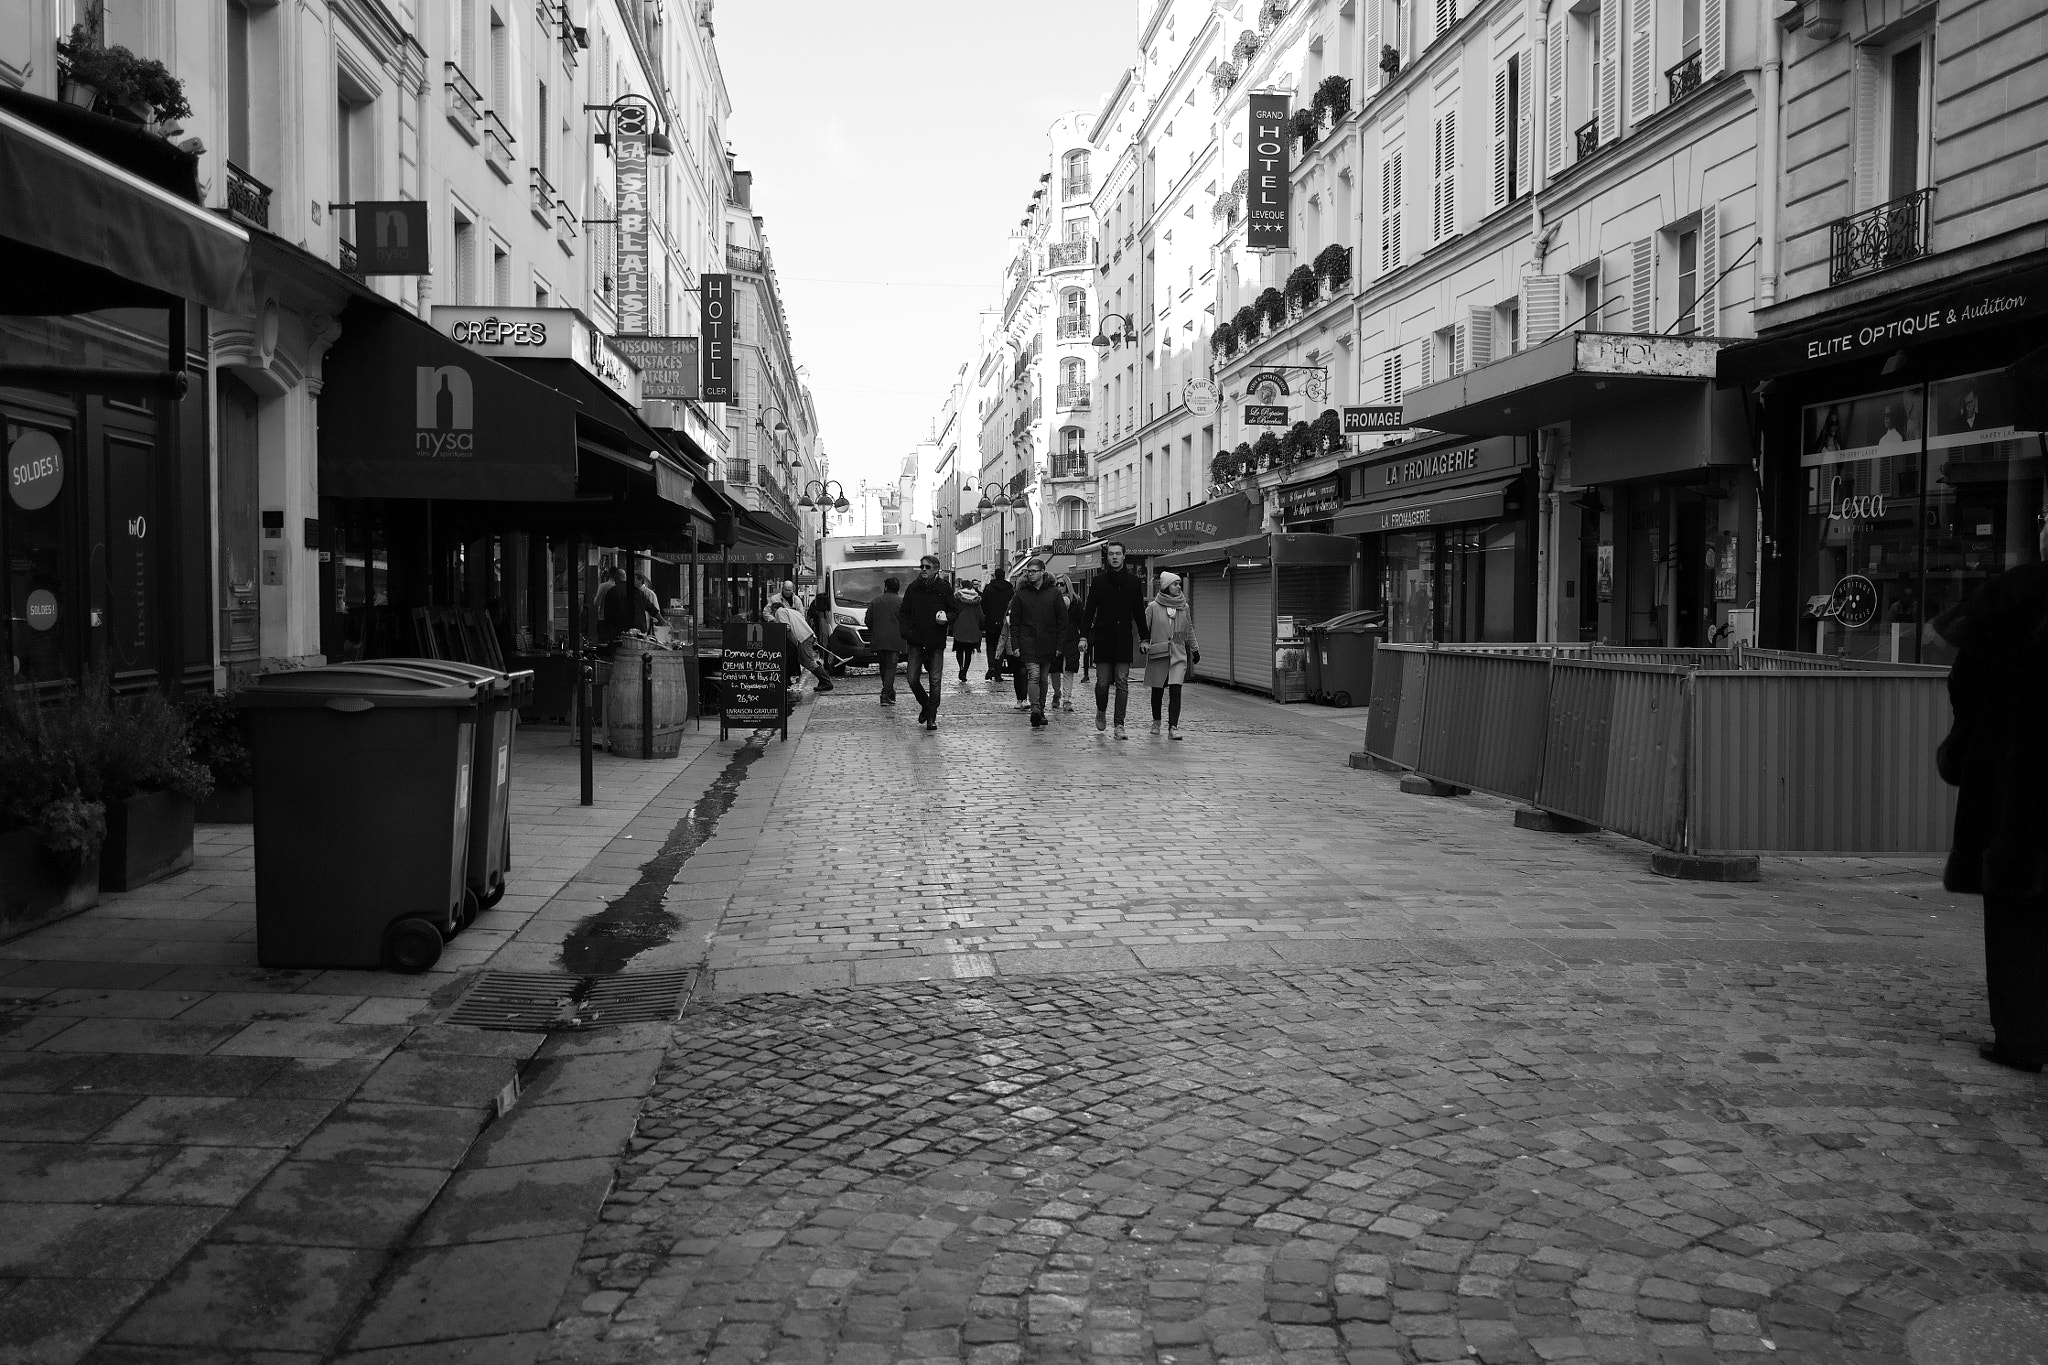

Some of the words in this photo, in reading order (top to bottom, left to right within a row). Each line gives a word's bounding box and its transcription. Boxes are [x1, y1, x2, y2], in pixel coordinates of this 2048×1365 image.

[1256, 111, 1284, 120] GRAND
[617, 141, 645, 158] LA
[1257, 125, 1281, 205] HOTEL
[1251, 210, 1285, 220] LEVEQUE
[376, 249, 409, 263] nysa
[620, 172, 645, 333] SABLAISE
[452, 316, 547, 345] CRÊPES
[708, 281, 723, 380] HOTEL
[1807, 334, 1853, 359] ELITE
[1858, 310, 1941, 346] OPTIQUE
[1946, 309, 1957, 324] &
[1961, 295, 2027, 321] Audition
[614, 340, 666, 354] OISSONS
[672, 340, 697, 354] FINS
[706, 387, 727, 395] CLER
[1191, 382, 1206, 391] PETIT
[416, 432, 473, 457] nysa
[13, 456, 53, 486] SOLDES
[1385, 466, 1398, 485] LA
[1403, 448, 1476, 482] FROMAGERIE
[1827, 475, 1888, 520] Lesca
[1381, 515, 1389, 528] LA
[1391, 508, 1431, 528] FROMAGERIE
[1154, 524, 1167, 536] LE
[1168, 520, 1193, 532] PETIT
[1195, 521, 1218, 536] CLER
[665, 553, 704, 562] TRAITER
[706, 553, 748, 562] ASIAIQUE
[724, 649, 755, 658] Domaine
